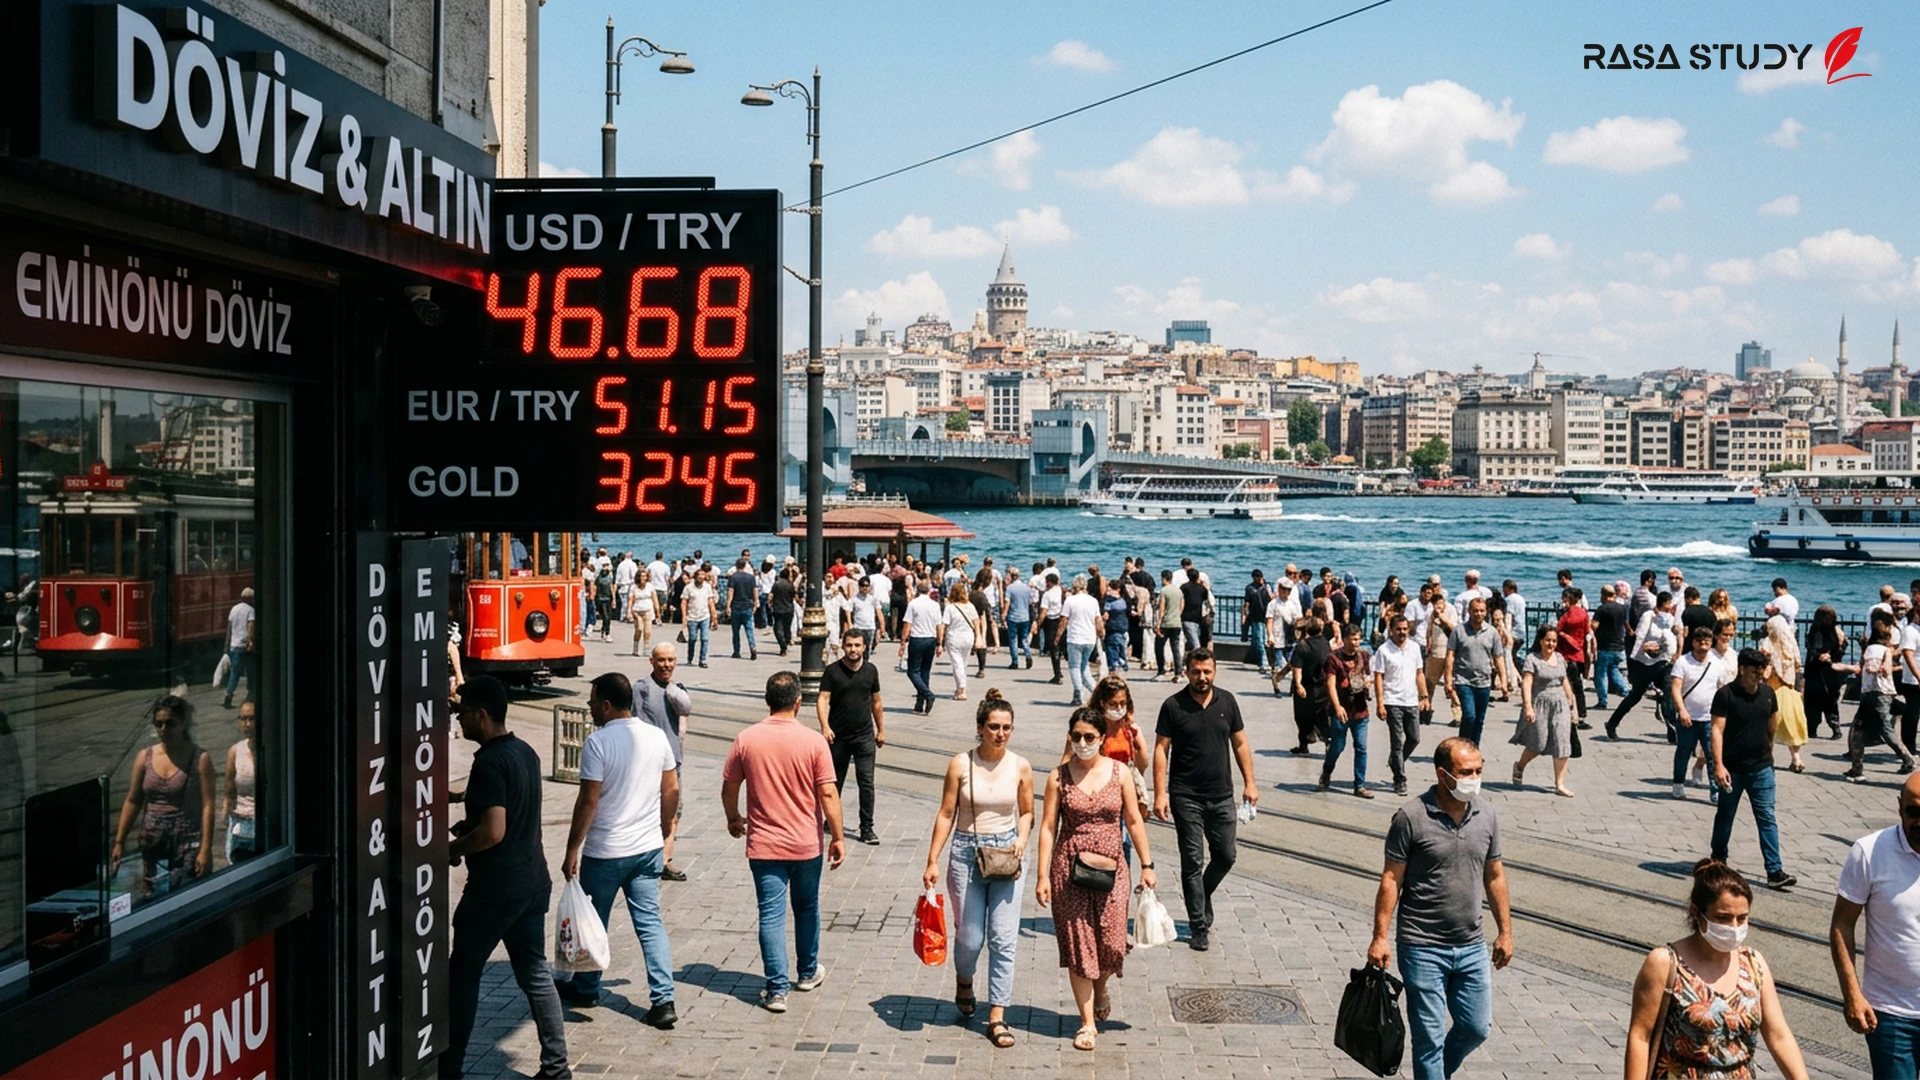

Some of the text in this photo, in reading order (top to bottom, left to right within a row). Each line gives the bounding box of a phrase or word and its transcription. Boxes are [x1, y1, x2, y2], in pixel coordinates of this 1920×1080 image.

[117, 3, 490, 254] DÖVİZ & ALTIN
[505, 213, 743, 251] USD / TRY
[16, 244, 292, 355] EMİNÖNÜ DÖVİZ
[486, 266, 751, 359] 46.68
[408, 390, 580, 422] EUR / TRY
[595, 376, 756, 434] 51.15
[408, 466, 519, 498] GOLD
[596, 452, 756, 511] 3245
[368, 563, 387, 796] DÖVİZ
[368, 818, 386, 856] &
[414, 567, 435, 1060] EMİNÖNÜ DÖVİZ
[101, 967, 269, 1080] NÖNÜ
